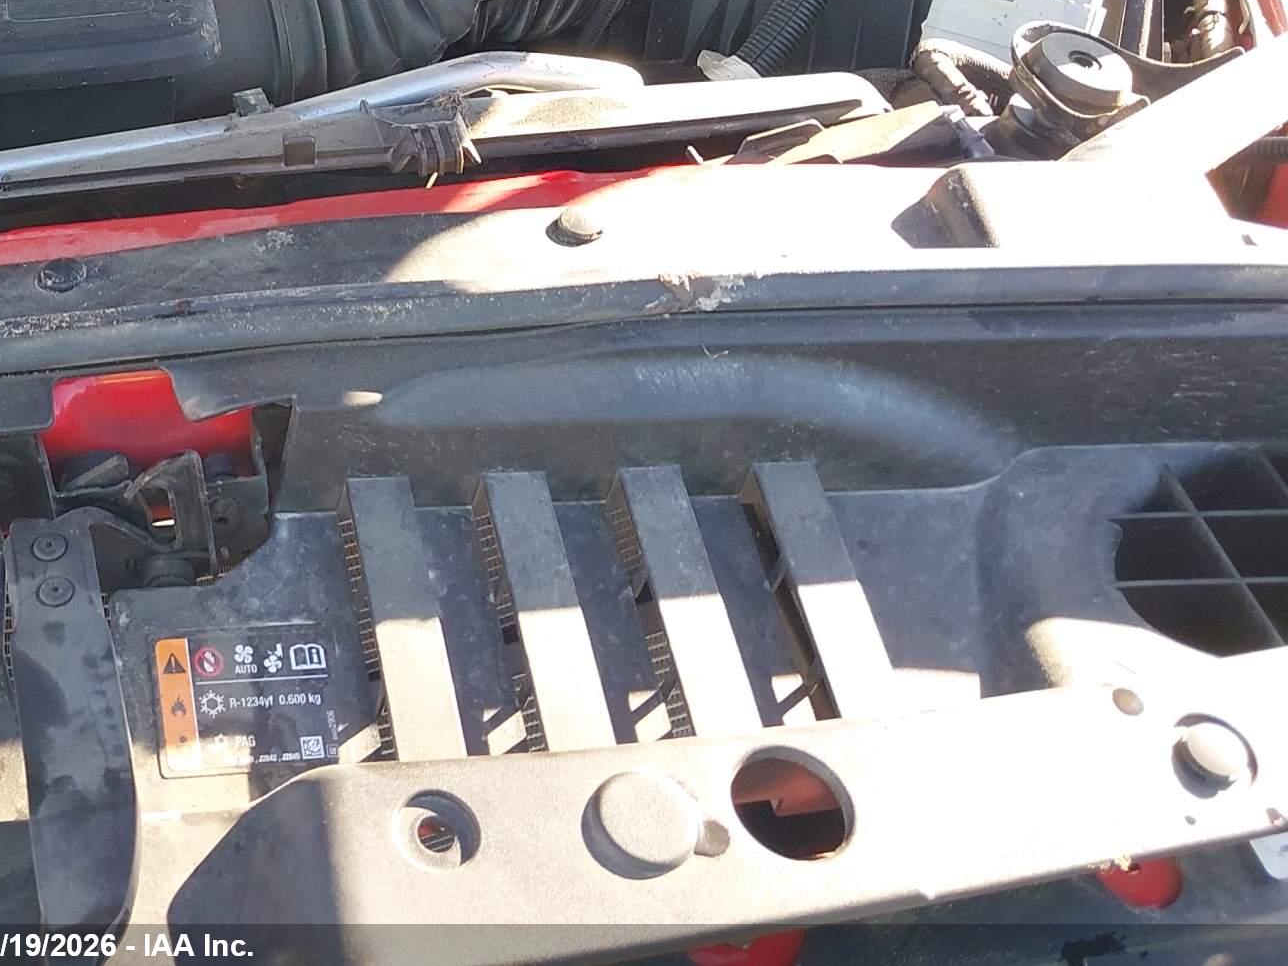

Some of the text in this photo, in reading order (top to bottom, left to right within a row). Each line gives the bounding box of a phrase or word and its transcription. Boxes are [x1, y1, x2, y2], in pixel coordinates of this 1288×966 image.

[235, 664, 257, 674] AUTO
[230, 693, 322, 709] R-1234yf 0.600 kg
[235, 735, 256, 747] PAG
